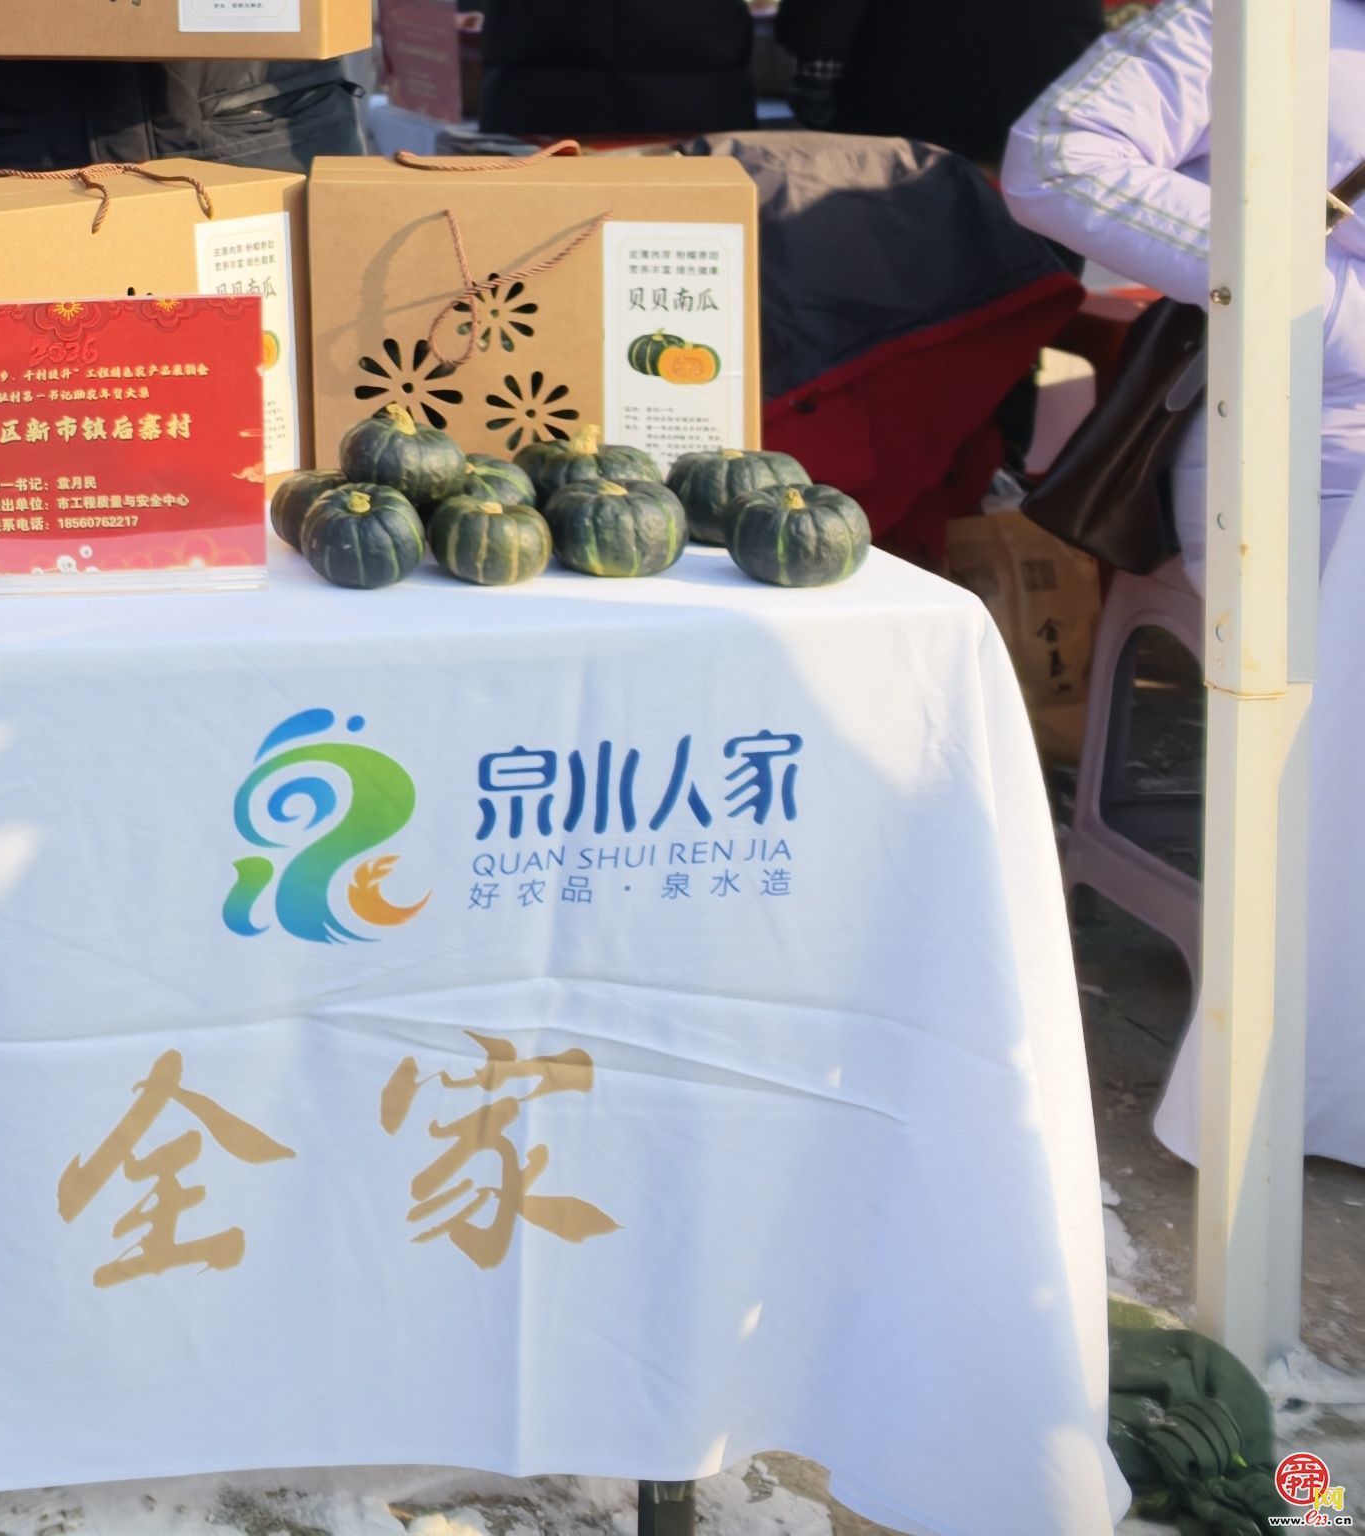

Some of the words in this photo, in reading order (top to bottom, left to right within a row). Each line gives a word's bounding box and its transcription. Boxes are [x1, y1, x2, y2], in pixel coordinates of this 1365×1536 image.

[627, 286, 720, 313] 贝贝南瓜
[475, 728, 804, 841] 泉水人家
[472, 846, 565, 878] QUAN
[578, 844, 657, 871] SHUI
[669, 839, 734, 865] REN
[742, 838, 793, 864] JIA
